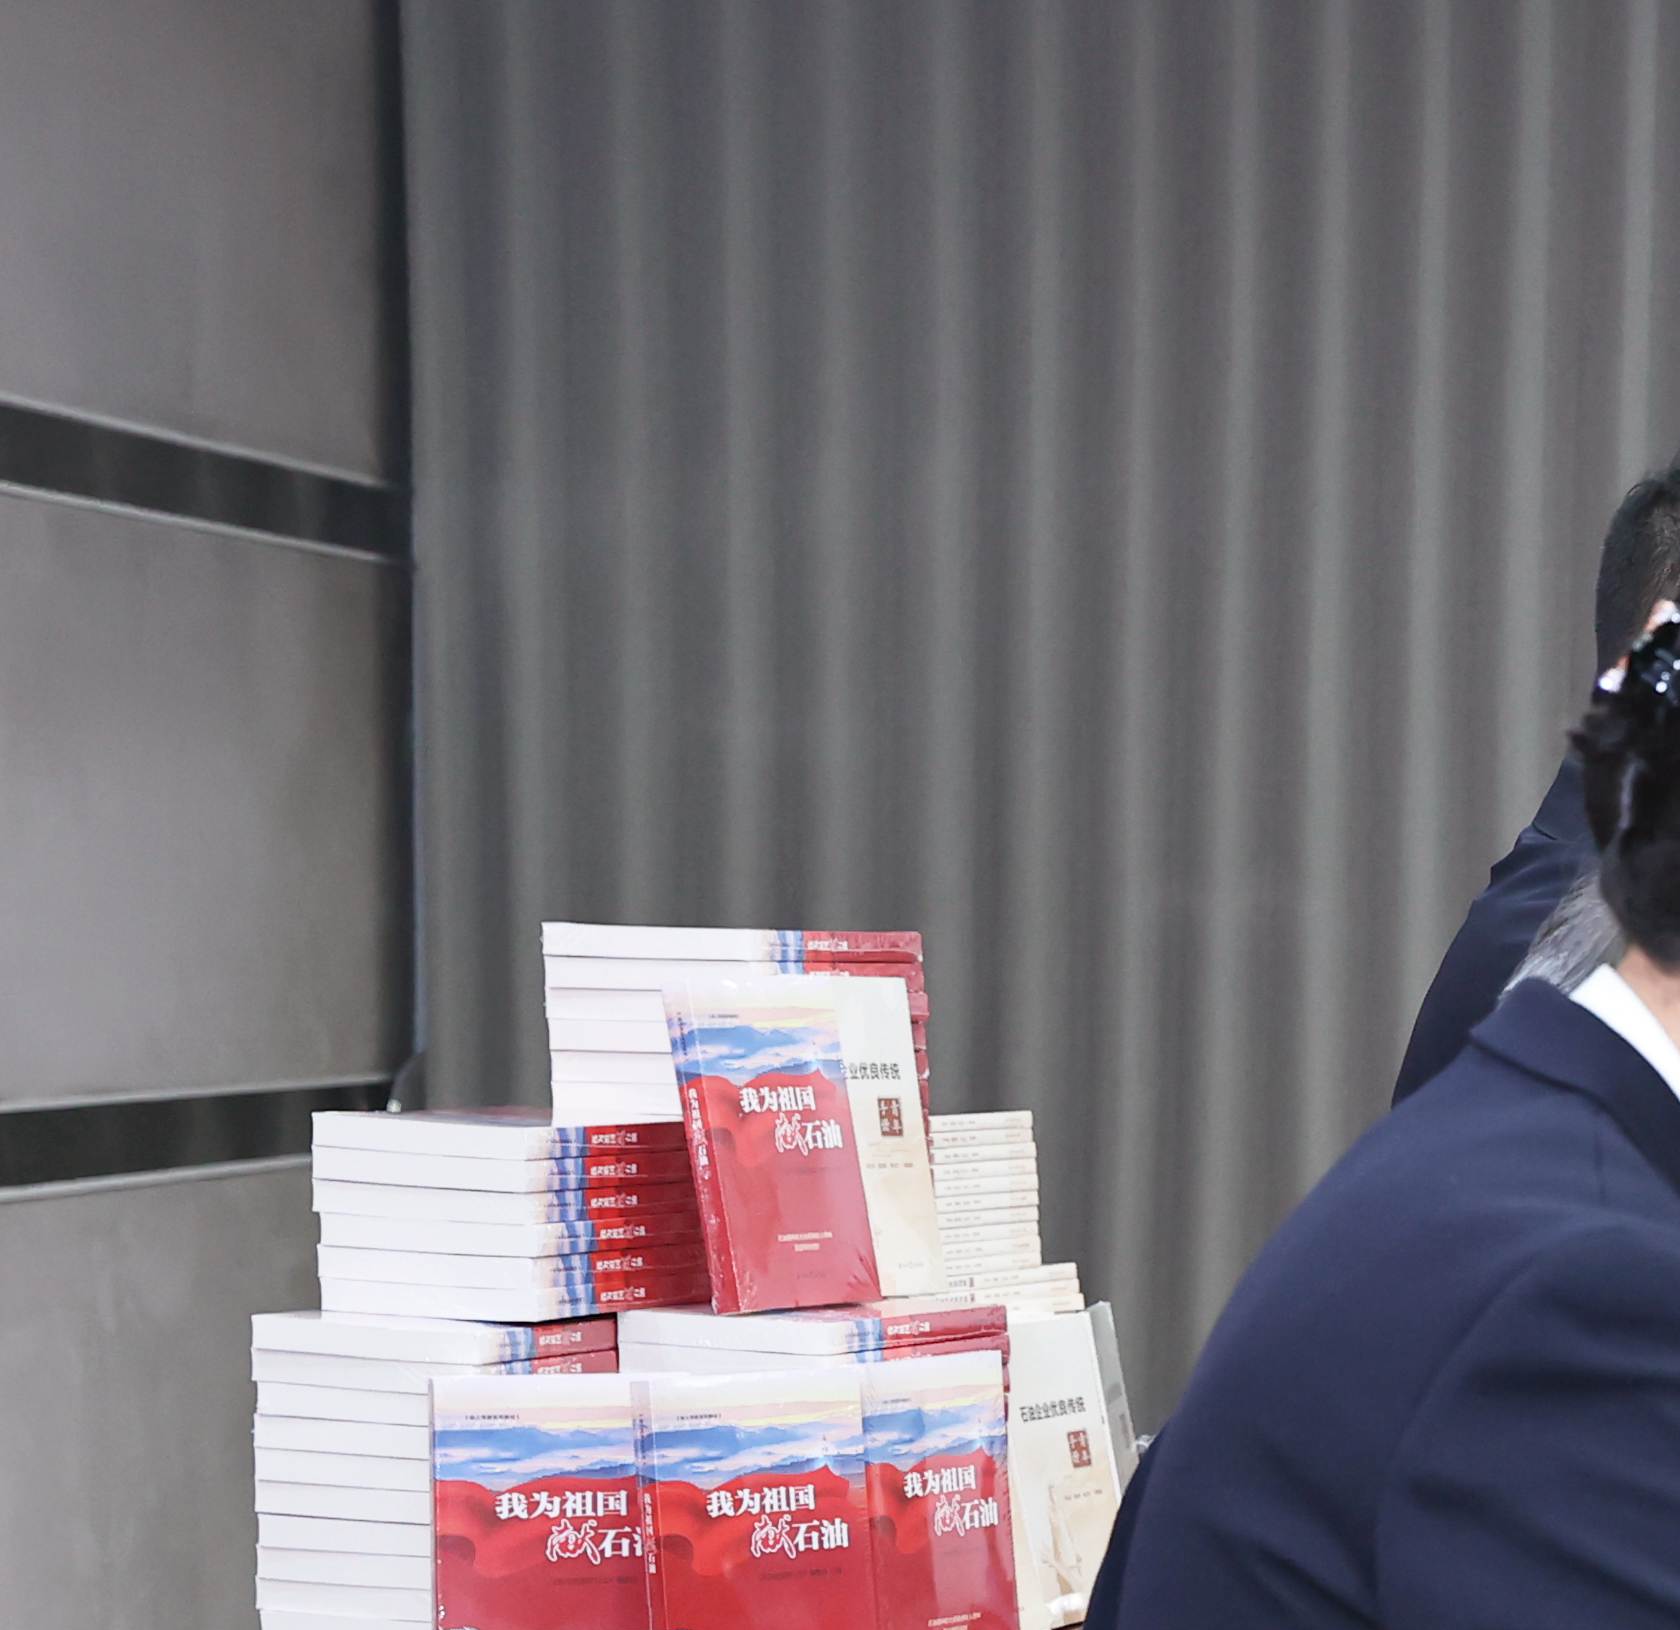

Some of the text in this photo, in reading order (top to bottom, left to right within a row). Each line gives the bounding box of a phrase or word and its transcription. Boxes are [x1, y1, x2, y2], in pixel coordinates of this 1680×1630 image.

[739, 1086, 816, 1113] 我为祖国
[775, 1112, 843, 1156] 献石油
[903, 1465, 977, 1499] 我为祖国
[495, 1490, 628, 1520] 我为祖国
[706, 1484, 816, 1518] 我为祖国
[934, 1493, 999, 1537] 献石油
[751, 1514, 849, 1560] 献石油
